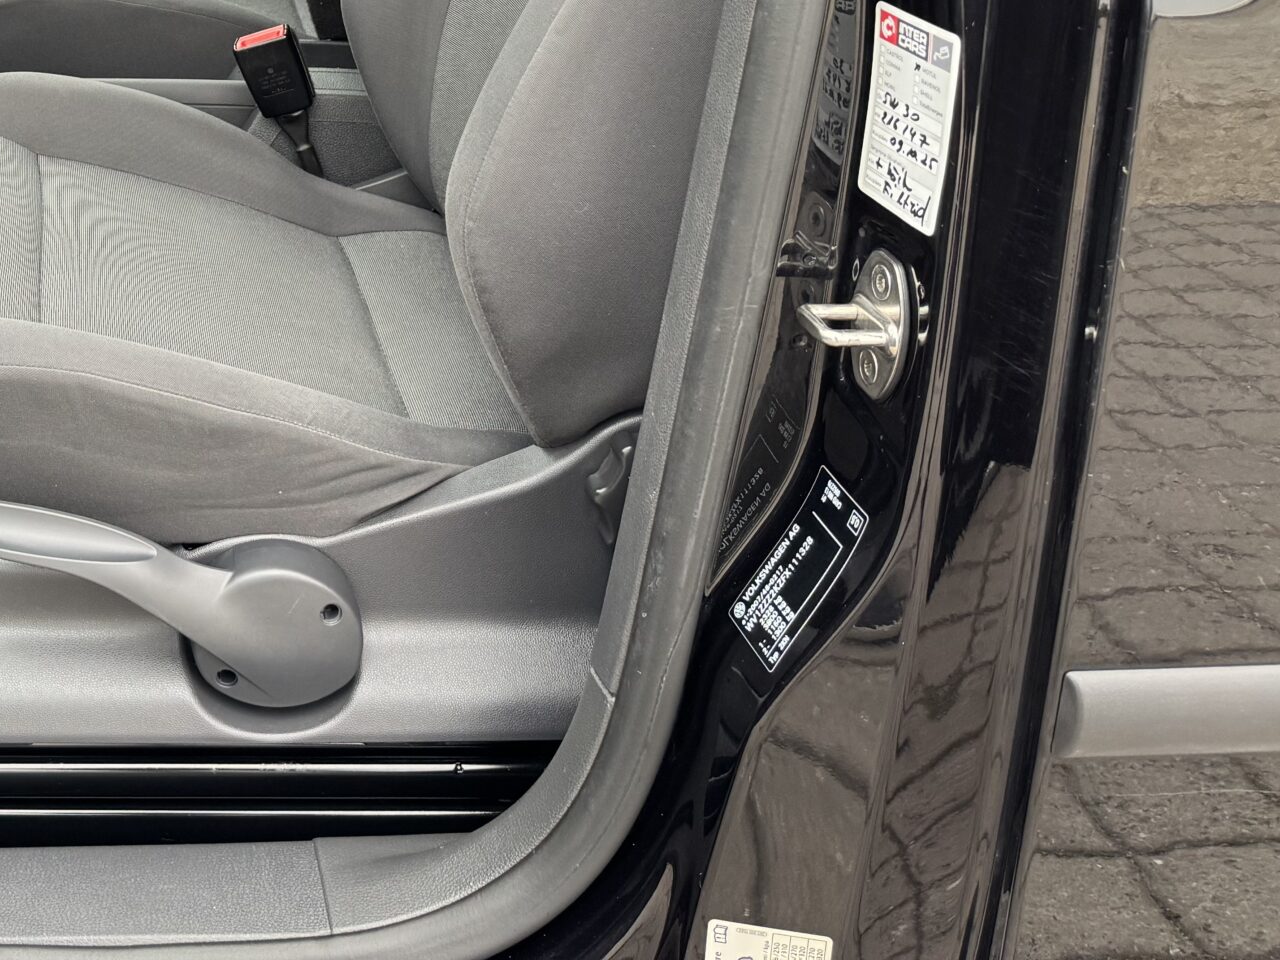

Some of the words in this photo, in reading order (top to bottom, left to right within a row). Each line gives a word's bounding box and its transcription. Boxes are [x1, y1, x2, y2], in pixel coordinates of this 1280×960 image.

[897, 33, 927, 58] CARS
[898, 21, 927, 45] INTER
[742, 537, 791, 601] VOLKSWAGEN
[787, 523, 800, 538] AG
